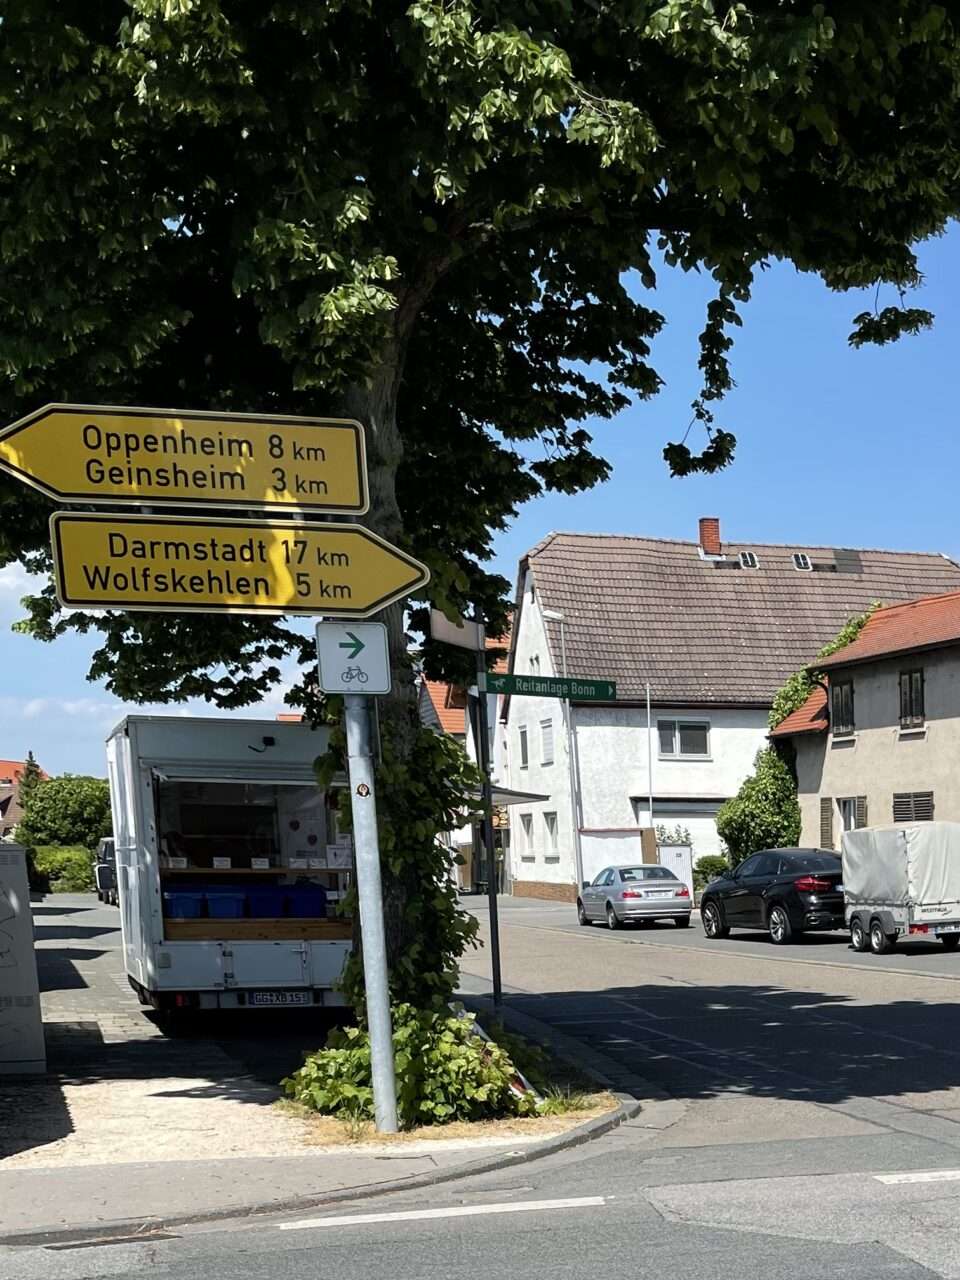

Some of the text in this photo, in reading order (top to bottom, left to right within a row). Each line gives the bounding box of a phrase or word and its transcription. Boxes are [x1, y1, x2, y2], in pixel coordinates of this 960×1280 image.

[82, 424, 326, 462] Oppenheim 8 km
[86, 459, 328, 495] Geinsheim 3 km
[108, 533, 349, 567] Darmstadt 17 km
[82, 565, 352, 599] Wolfskehlen 5 km
[515, 678, 596, 696] Reitanlage Bonn
